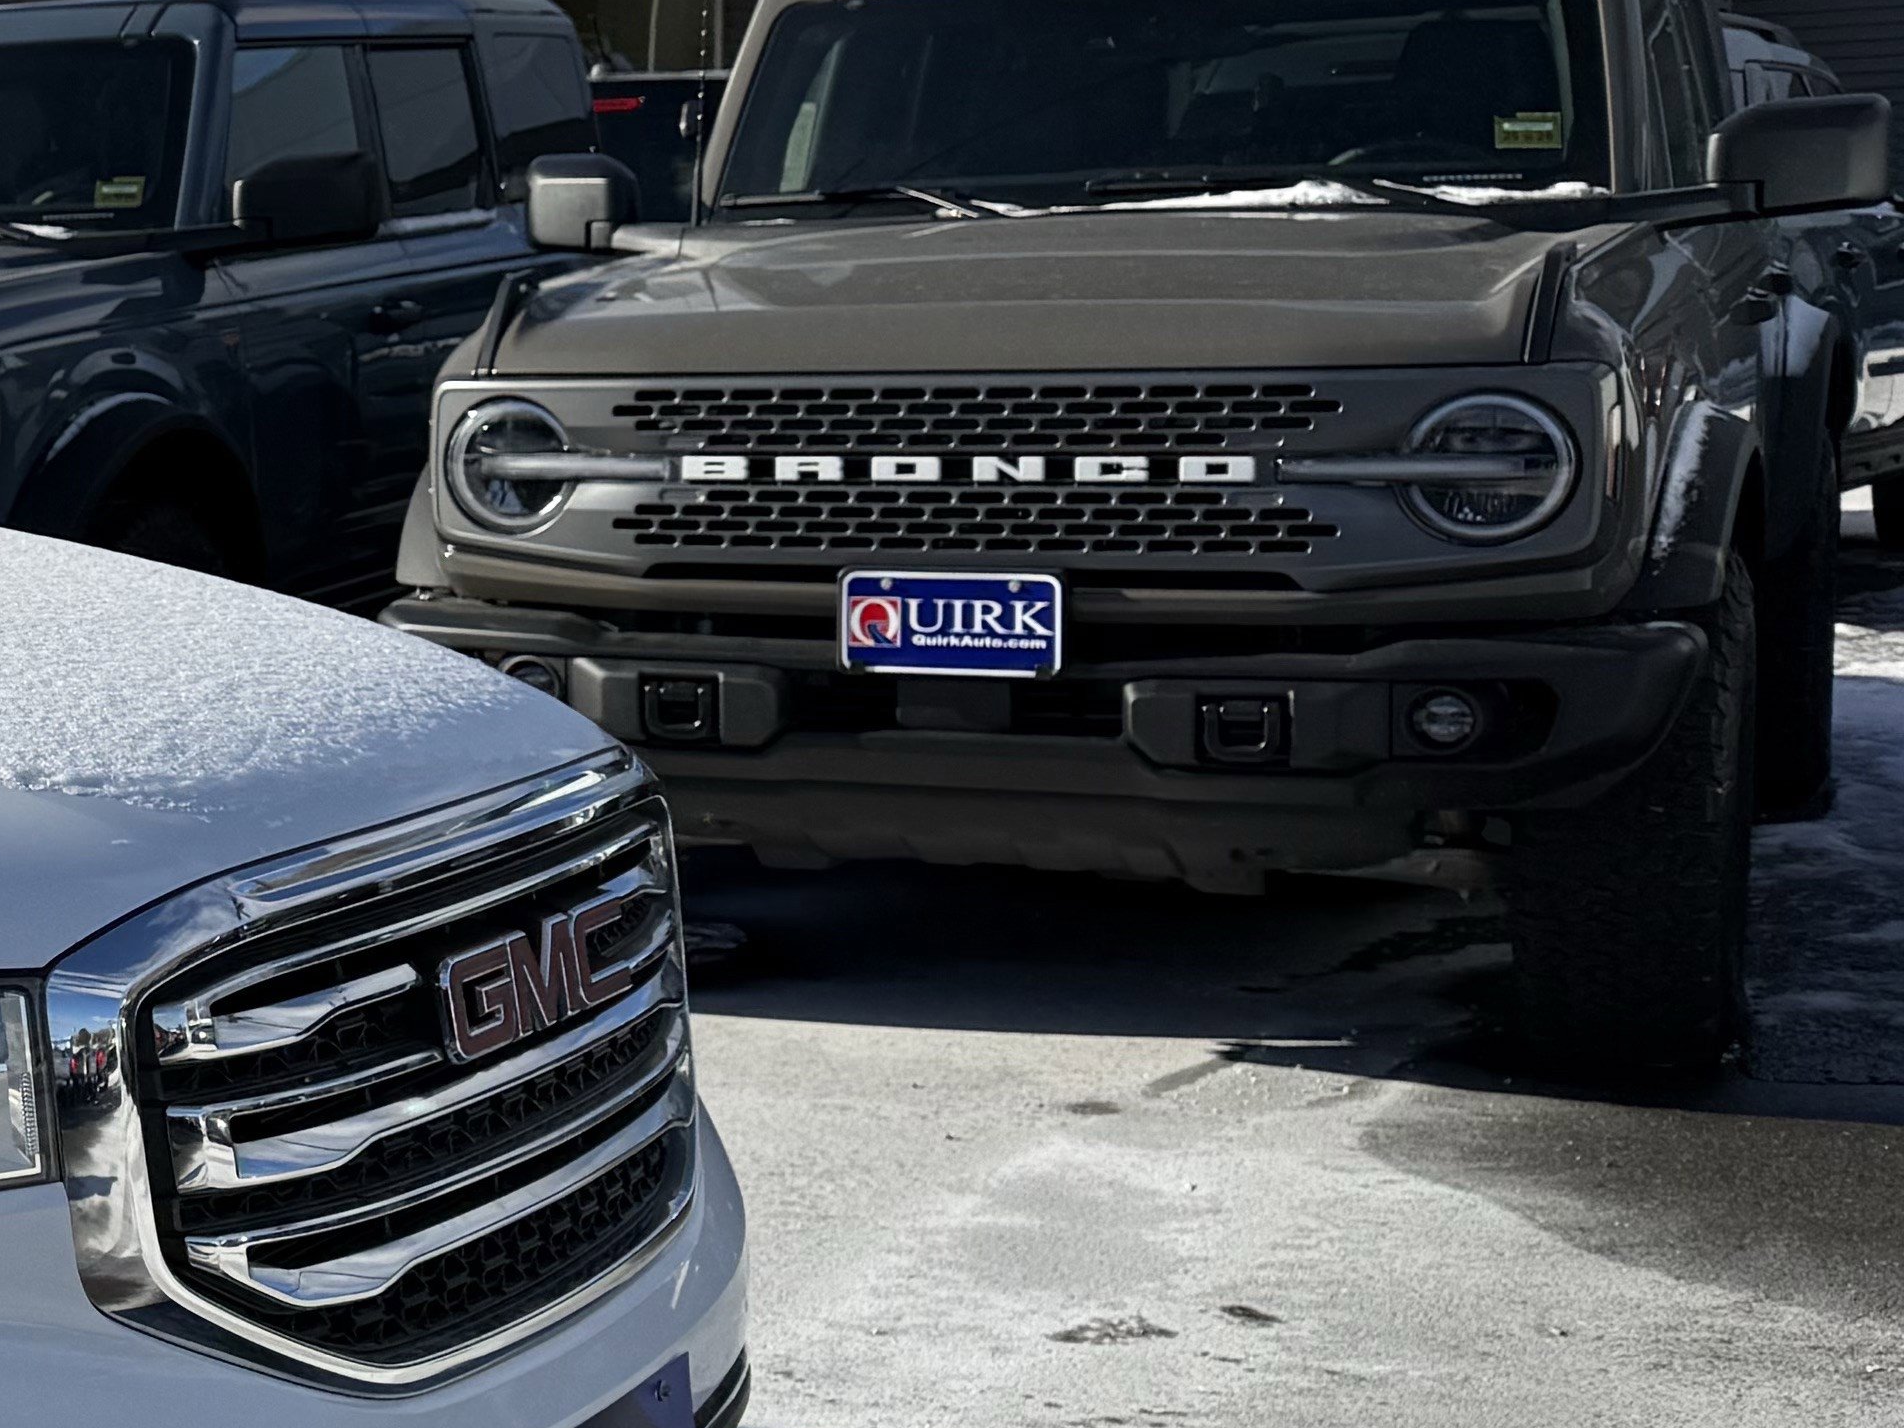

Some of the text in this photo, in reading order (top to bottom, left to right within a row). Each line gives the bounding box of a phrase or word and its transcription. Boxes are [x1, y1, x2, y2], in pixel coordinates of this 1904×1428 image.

[681, 455, 1256, 483] BRONCO
[849, 597, 1055, 648] QUIRK
[911, 633, 1048, 650] QuirkAuto.com
[439, 890, 634, 1064] GMC
